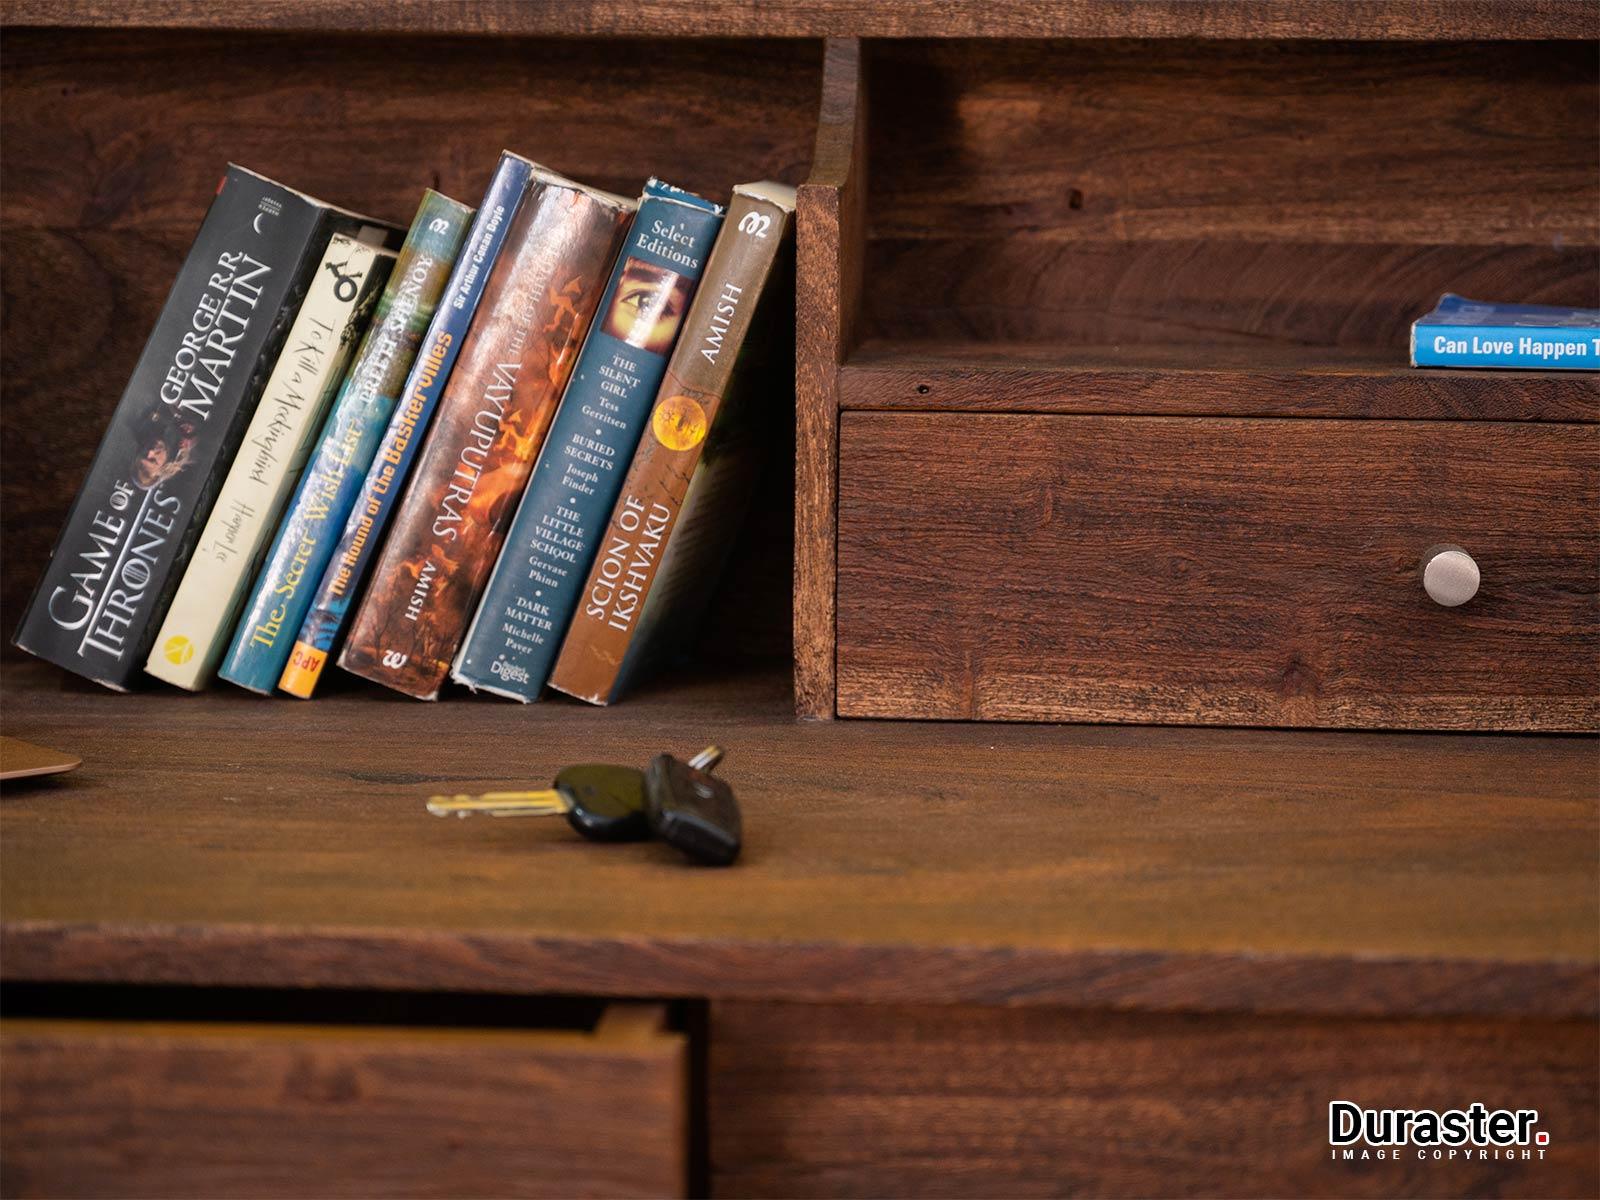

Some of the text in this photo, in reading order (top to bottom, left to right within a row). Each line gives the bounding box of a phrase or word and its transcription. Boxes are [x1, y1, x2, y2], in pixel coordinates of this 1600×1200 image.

[652, 219, 696, 248] Select
[453, 205, 505, 310] Sir Arthur Conan Doyle
[636, 233, 698, 269] Editions
[700, 282, 742, 364] AMISH
[160, 292, 221, 405] GEORGE
[178, 253, 272, 420] MARTIN
[1433, 336, 1467, 354] Can
[1473, 336, 1513, 355] Love
[1519, 337, 1587, 360] Happen
[293, 341, 325, 376] Kill
[612, 354, 637, 372] THE
[598, 365, 641, 388] SILENT
[600, 381, 627, 398] GIRL
[599, 396, 619, 412] Tess
[581, 405, 627, 430] Gerritsen
[249, 380, 305, 487] Mockingbird
[572, 433, 615, 457] BURIED
[328, 329, 453, 597] The Hound of the Baskervilles
[432, 361, 522, 542] VAYUPUTRAS
[564, 445, 614, 471] SECRETS
[562, 475, 595, 496] Finder
[566, 463, 599, 483] Joseph
[542, 515, 585, 537] LITTLE
[556, 505, 581, 522] THE
[529, 539, 576, 563] SCHOOL
[535, 526, 585, 552] VILLAGE
[48, 479, 135, 631] GAME OF
[250, 604, 286, 649] The
[275, 528, 317, 600] Secret
[304, 471, 345, 522] Wish
[528, 555, 568, 577] Gervase
[586, 494, 646, 620] SCION OF
[608, 503, 671, 632] IKSHVAKU
[78, 486, 181, 660] THRONES
[528, 569, 558, 588] Phinn
[404, 560, 437, 622] AMISH
[516, 596, 550, 616] DARK
[504, 607, 553, 631] MATTER
[502, 622, 544, 645] Michelle
[505, 637, 533, 655] Paver
[490, 660, 530, 684] Digest
